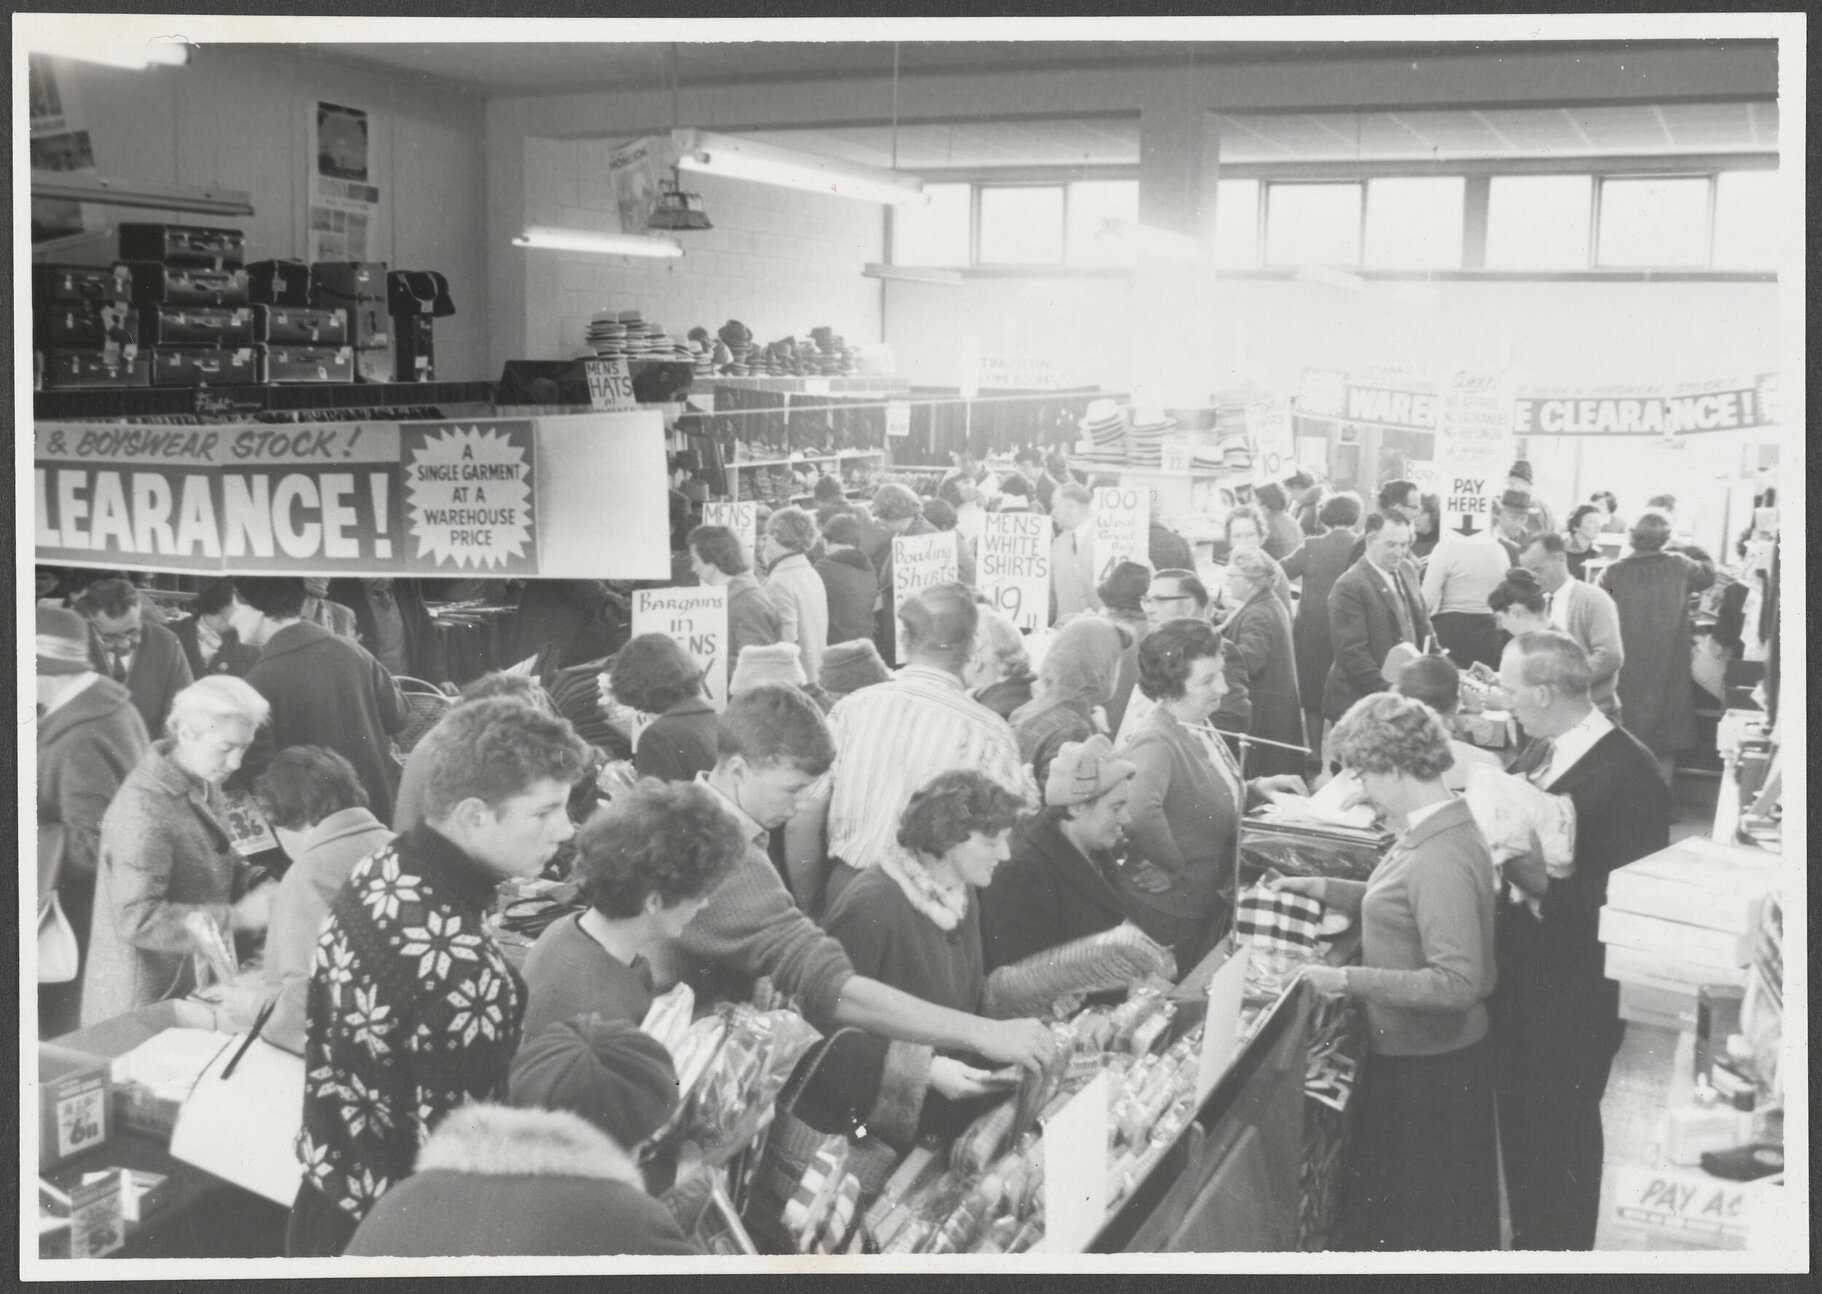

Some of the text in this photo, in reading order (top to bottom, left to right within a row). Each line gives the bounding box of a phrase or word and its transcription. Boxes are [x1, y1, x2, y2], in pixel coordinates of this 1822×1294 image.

[587, 362, 619, 376] MENS
[589, 376, 633, 398] HATS
[50, 427, 361, 461] & BOYSWEAR STOCK!
[462, 444, 473, 460] A
[417, 464, 521, 481] SINGLE GARMENT
[452, 486, 486, 503] AT A
[1453, 478, 1486, 494] PAY
[1447, 496, 1488, 513] HERE
[424, 508, 515, 525] WAREHOUSE
[705, 504, 751, 527] MENS
[985, 514, 1041, 535] MENS
[450, 530, 492, 546] PRICE
[984, 534, 1040, 556] WHITE
[984, 554, 1047, 578] SHIRTS
[1640, 1180, 1697, 1212] PAY
